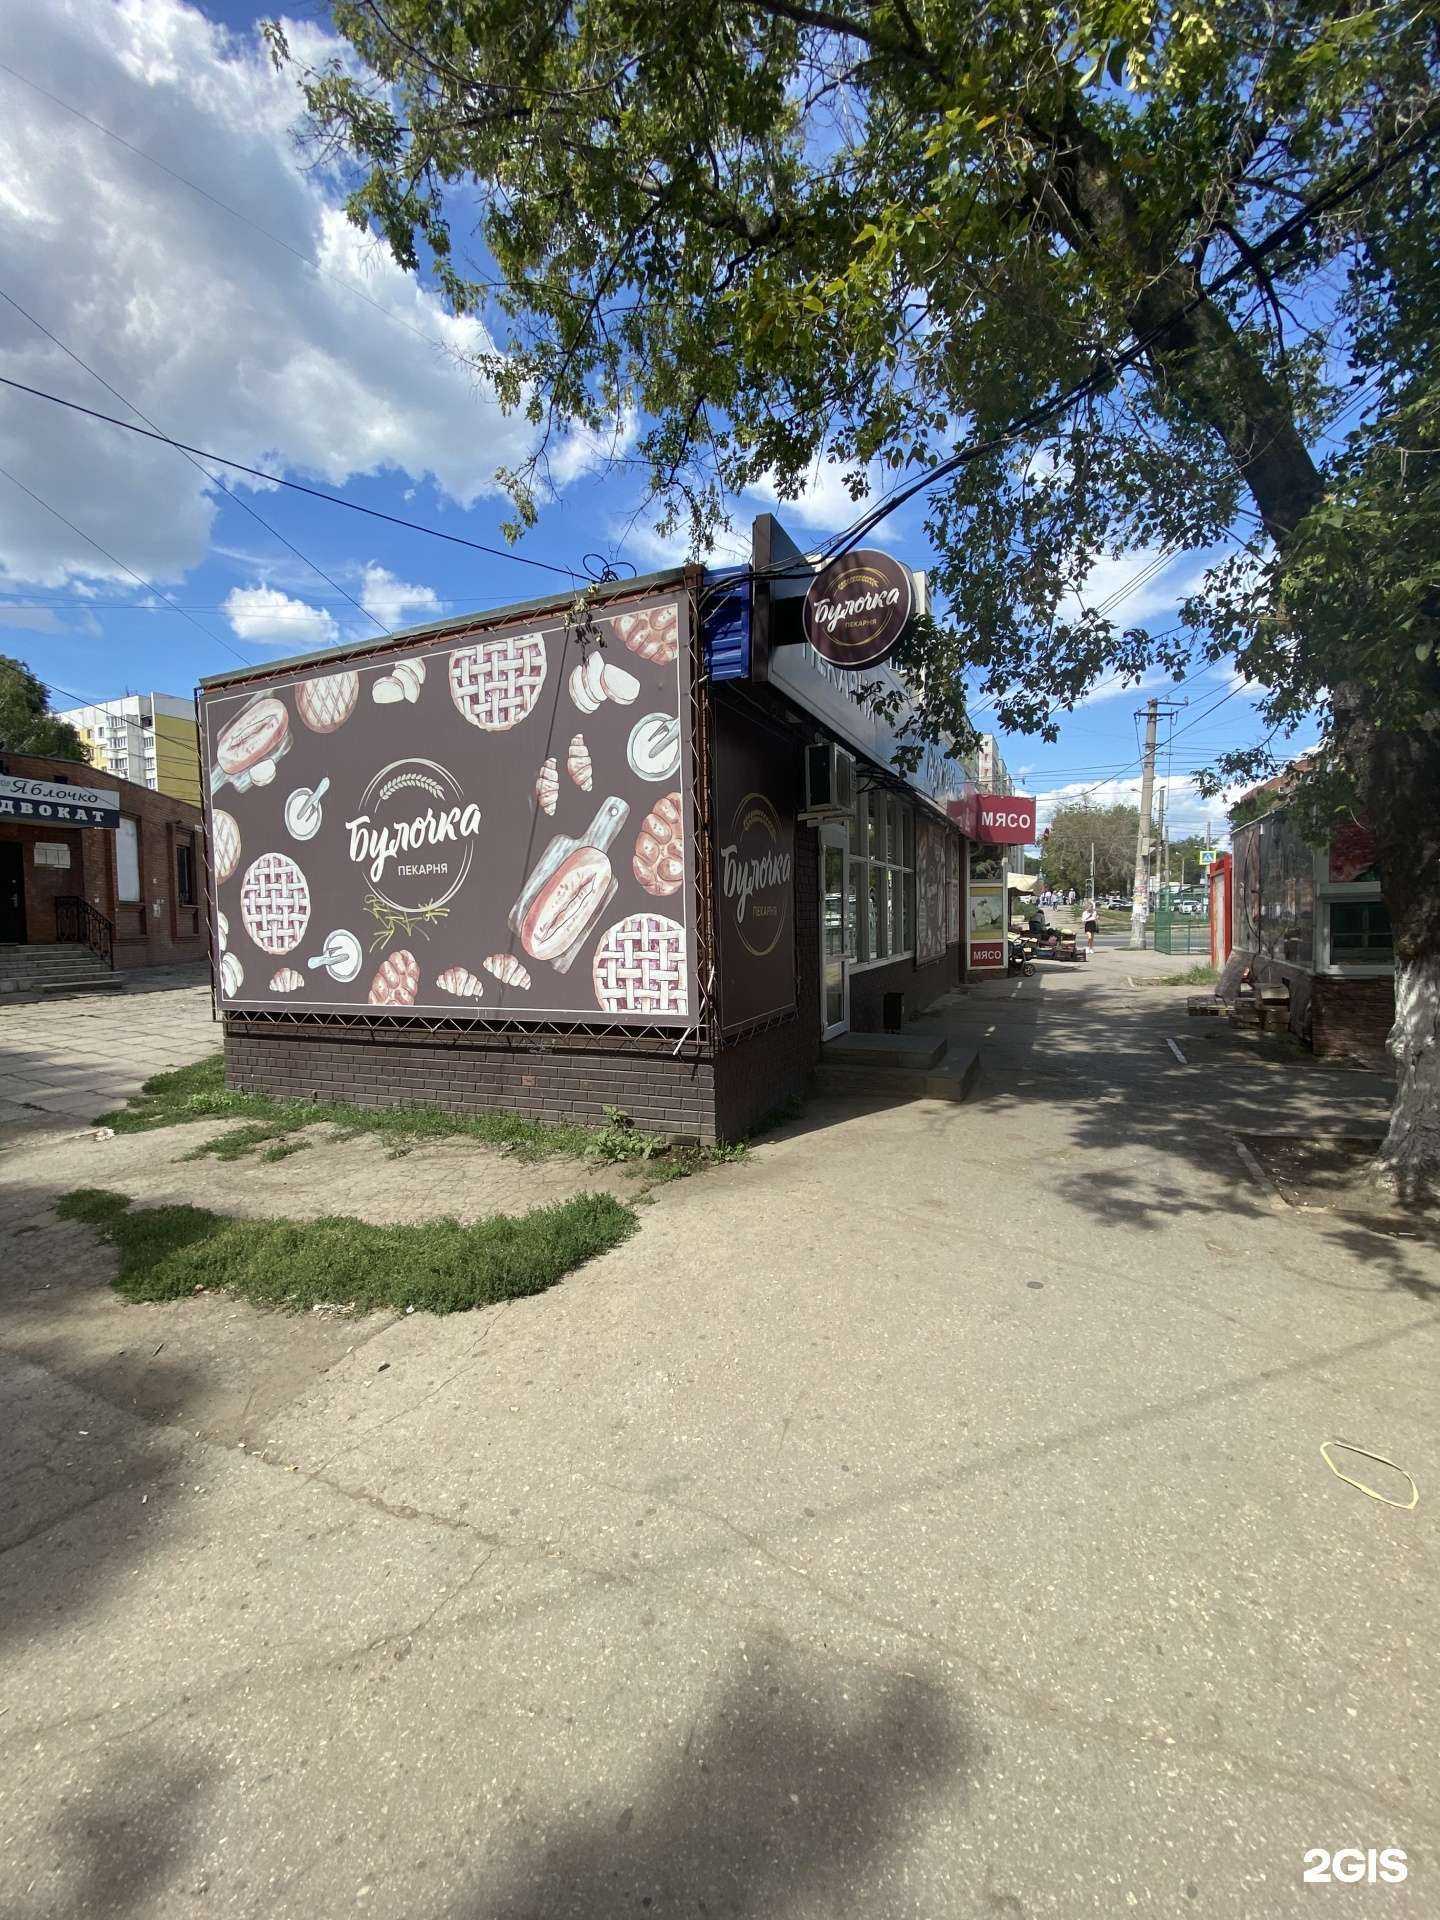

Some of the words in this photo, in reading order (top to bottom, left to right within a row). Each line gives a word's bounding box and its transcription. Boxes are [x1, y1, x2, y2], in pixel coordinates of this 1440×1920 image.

[813, 588, 900, 633] Булочка
[10, 780, 98, 803] Яблочко
[981, 811, 1031, 829] МЯСО
[345, 803, 482, 883] Булочка
[398, 863, 448, 876] ПЕКАРНЯ
[721, 844, 791, 924] Булочка
[973, 950, 1002, 961] МЯСО
